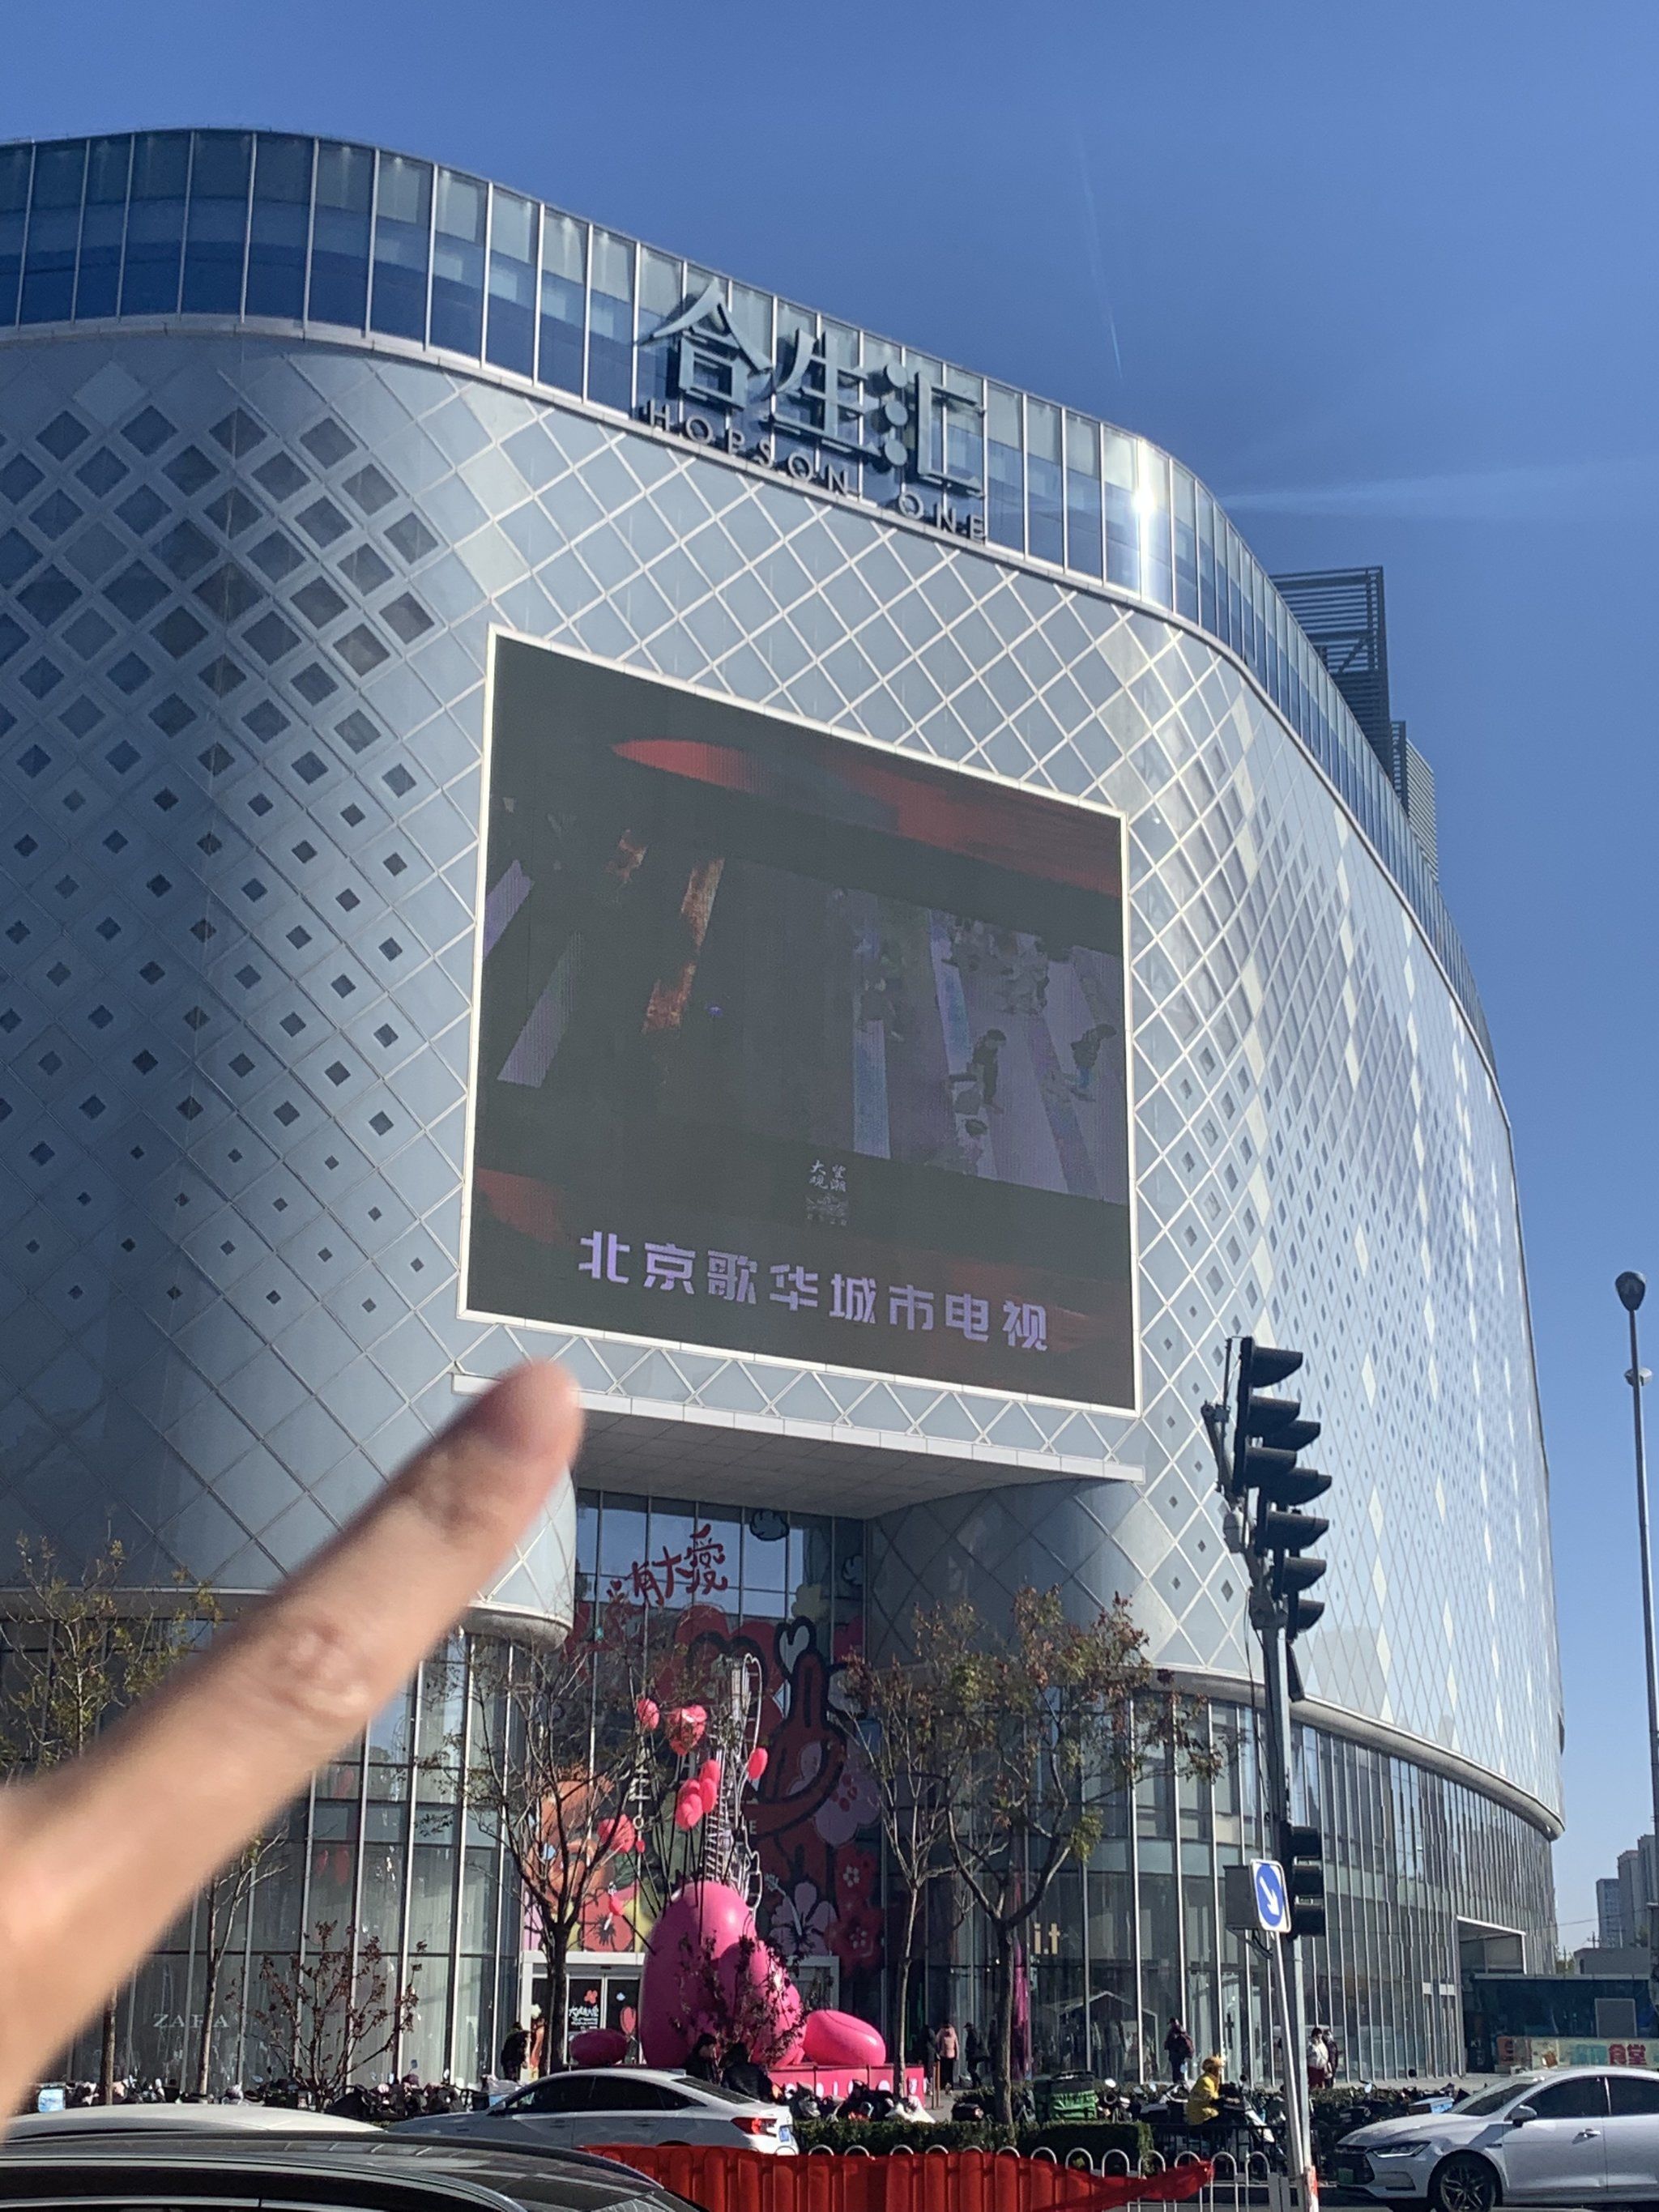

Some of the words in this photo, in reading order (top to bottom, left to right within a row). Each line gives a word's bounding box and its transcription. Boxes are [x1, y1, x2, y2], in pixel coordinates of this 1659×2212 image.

[638, 276, 986, 499] 合生汇
[650, 397, 850, 497] HOPSON
[898, 491, 986, 543] ONE
[578, 1230, 1048, 1351] 北京歌华城市电视
